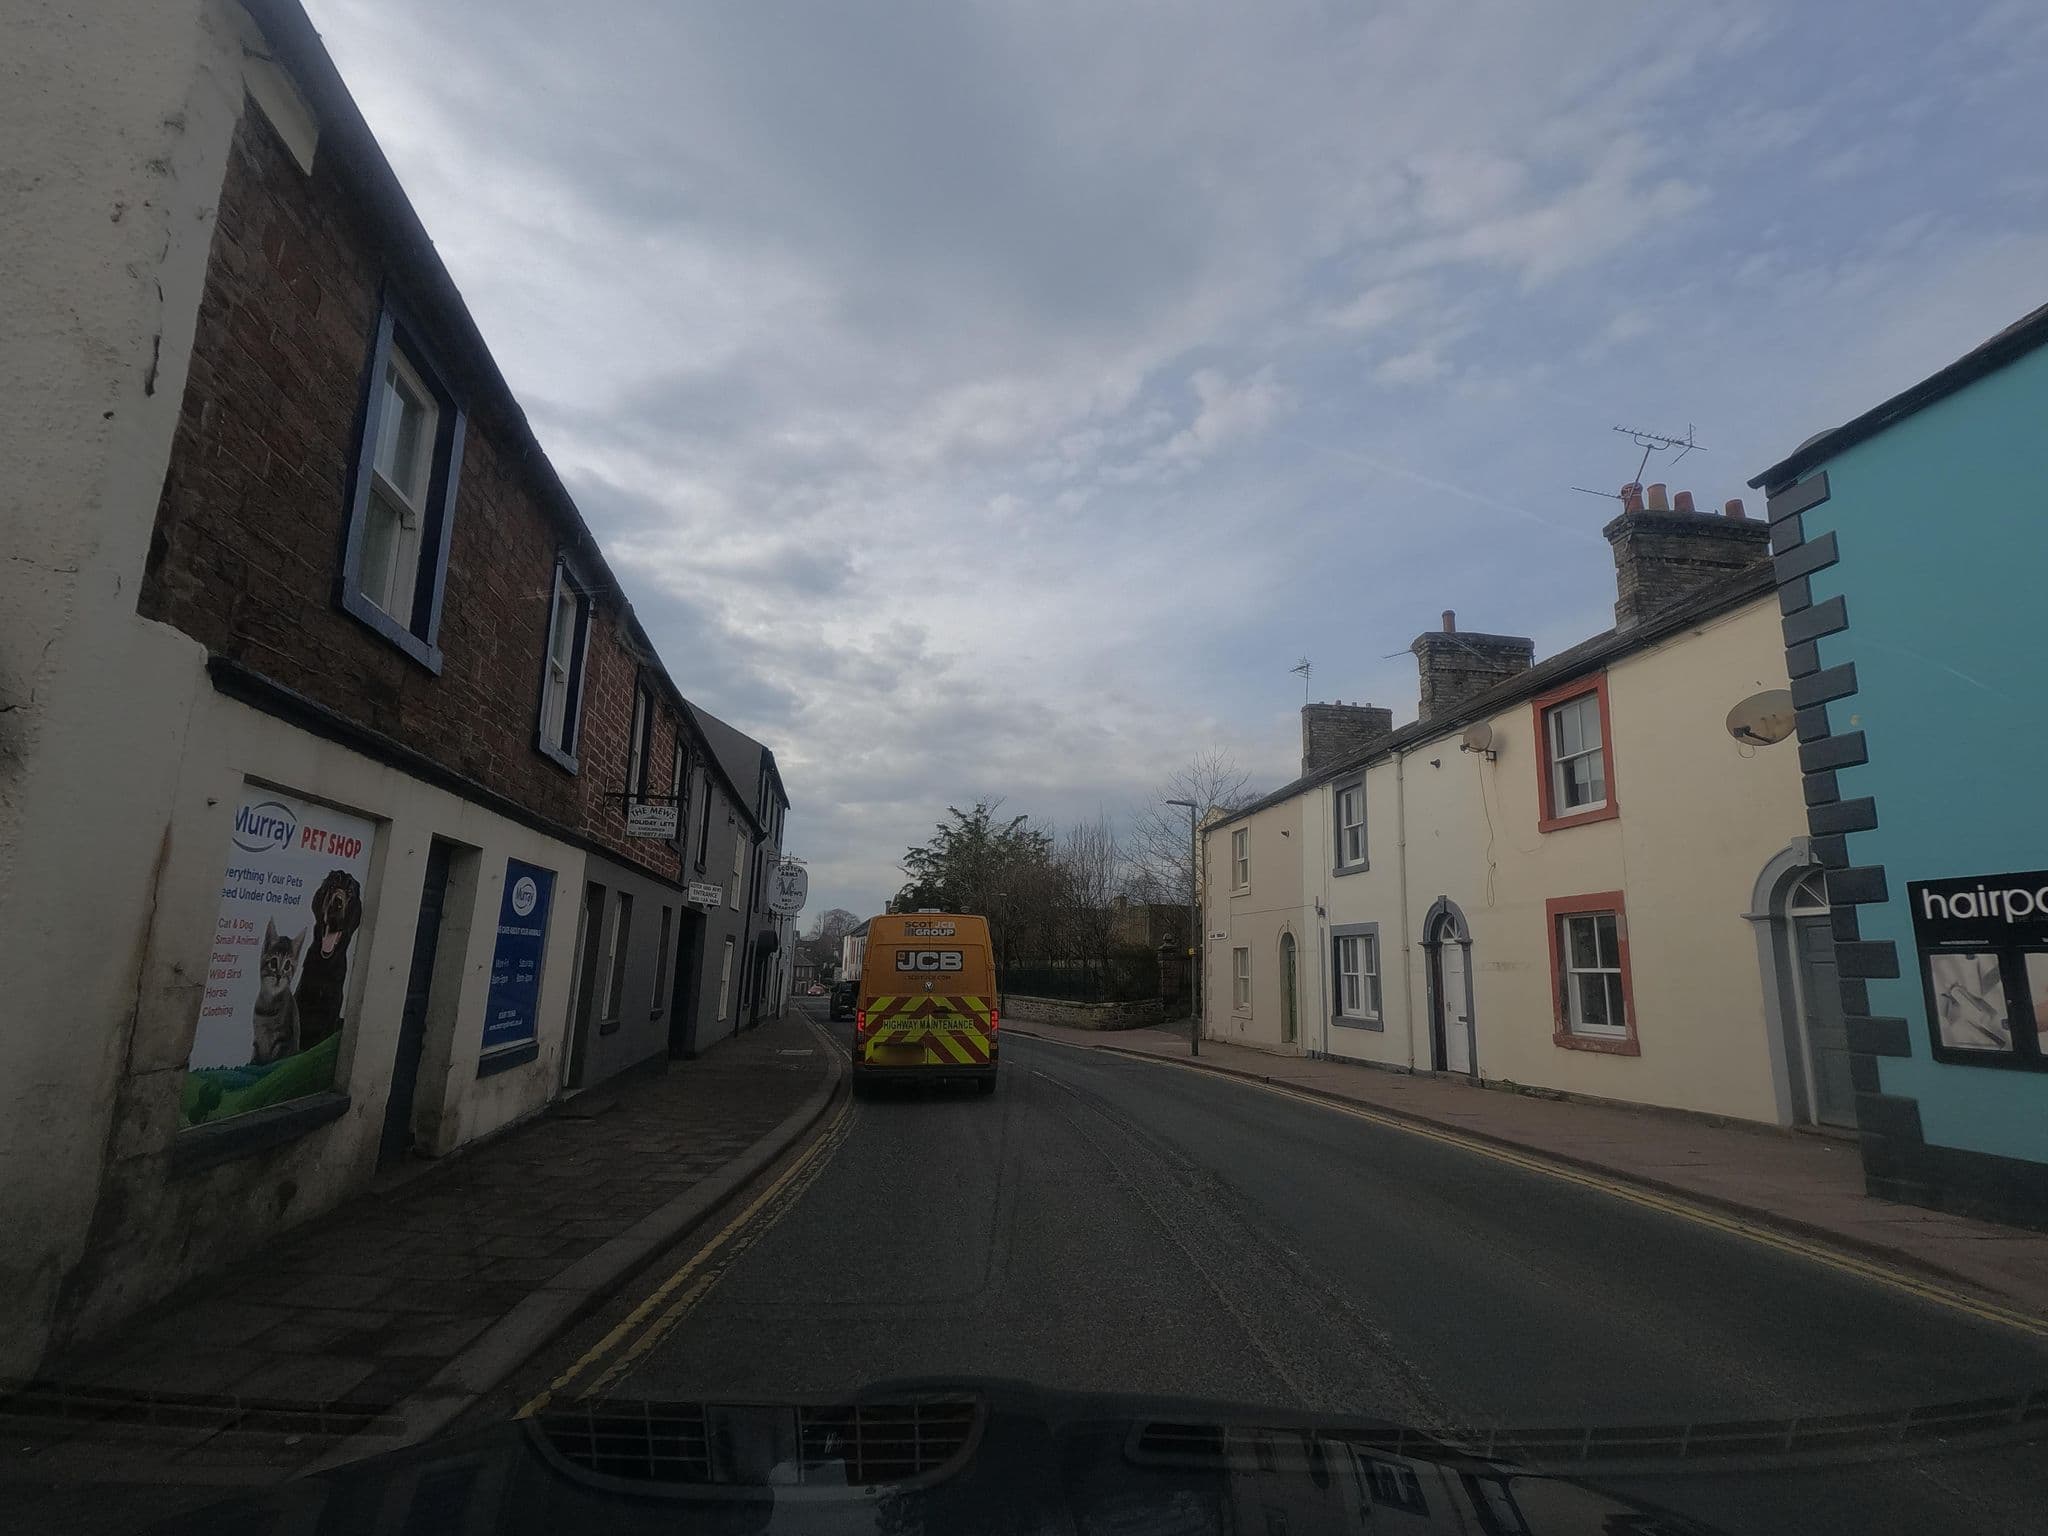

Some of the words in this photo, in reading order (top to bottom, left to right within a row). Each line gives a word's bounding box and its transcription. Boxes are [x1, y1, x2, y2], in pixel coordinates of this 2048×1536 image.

[630, 807, 648, 817] THE
[650, 807, 676, 819] MEWS
[301, 826, 327, 851] PET
[327, 833, 362, 859] SHOP
[267, 871, 285, 885] Your
[286, 874, 303, 888] Pets
[239, 887, 264, 902] Under
[267, 890, 282, 903] One
[284, 894, 301, 906] Roof
[218, 918, 231, 929] Cat
[239, 919, 254, 932] Dog
[915, 928, 954, 936] GROUP
[897, 952, 962, 970] JCB
[883, 1020, 918, 1030] HIGHWAY
[920, 1020, 973, 1029] MAINTENANCE
